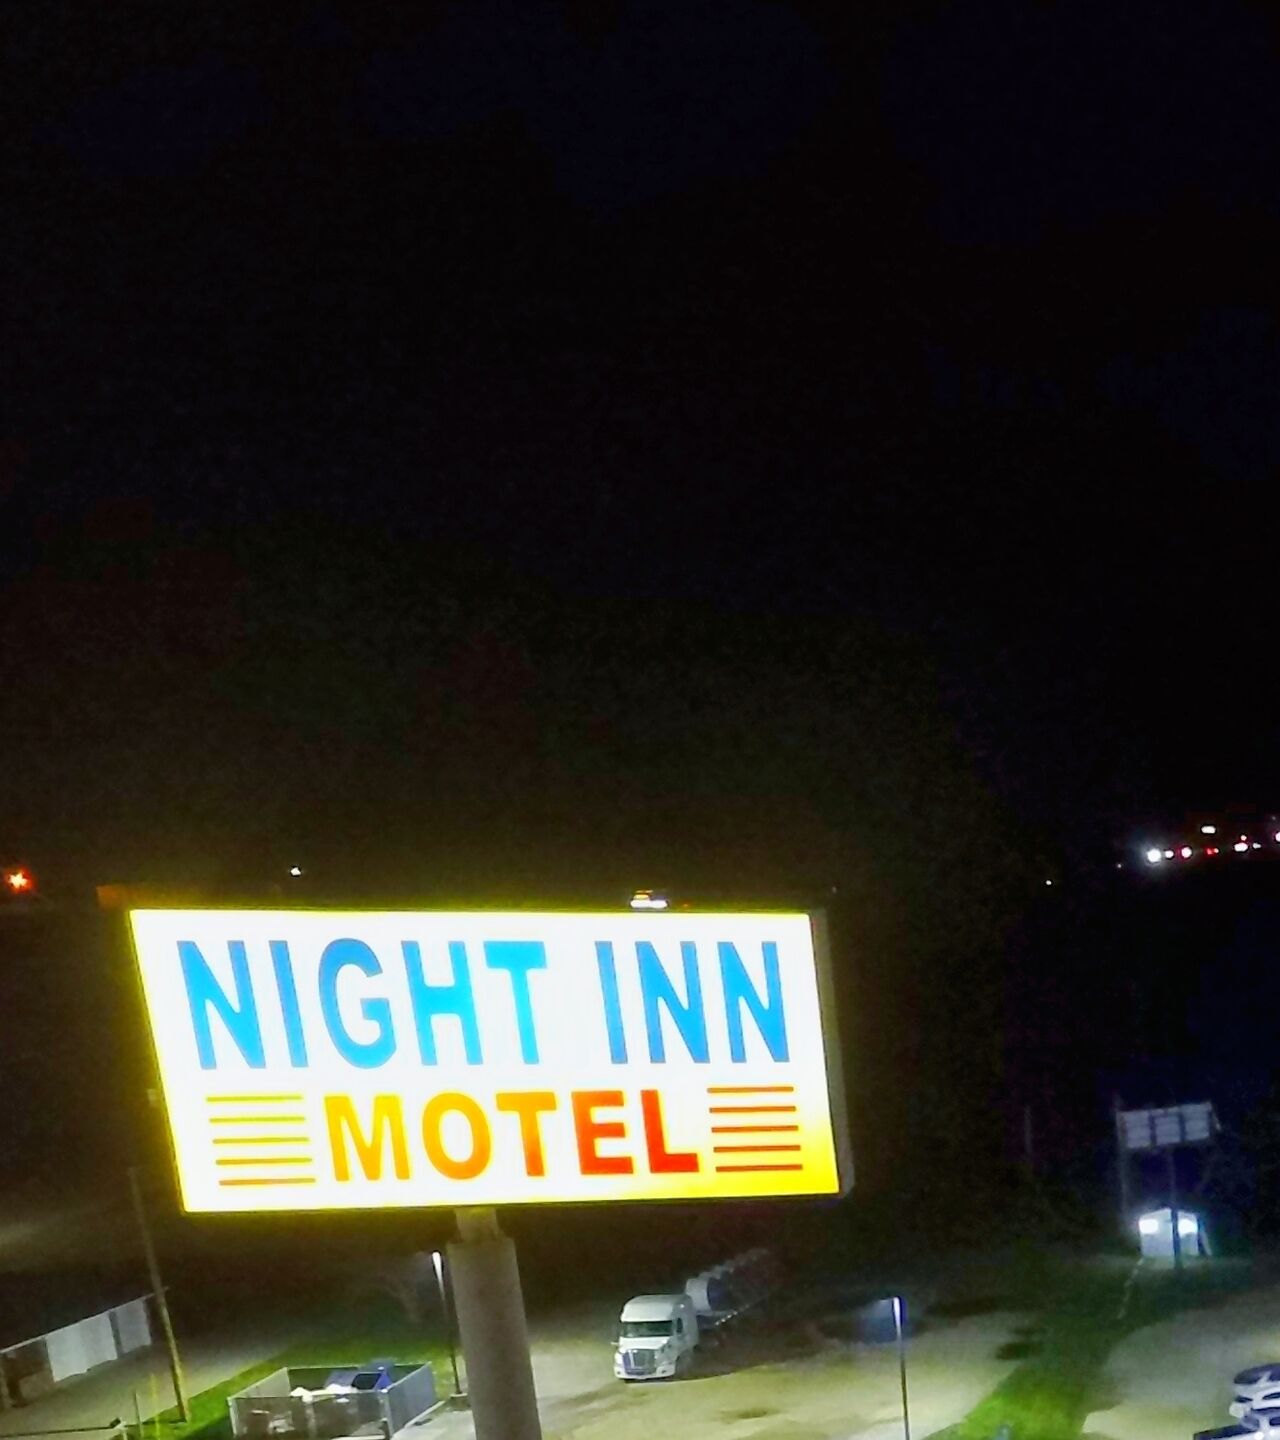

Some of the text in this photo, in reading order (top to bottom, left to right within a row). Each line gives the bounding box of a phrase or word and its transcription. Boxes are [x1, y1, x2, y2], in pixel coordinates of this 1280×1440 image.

[176, 938, 791, 1070] NIGHT INN
[323, 1089, 700, 1181] MOTEL
